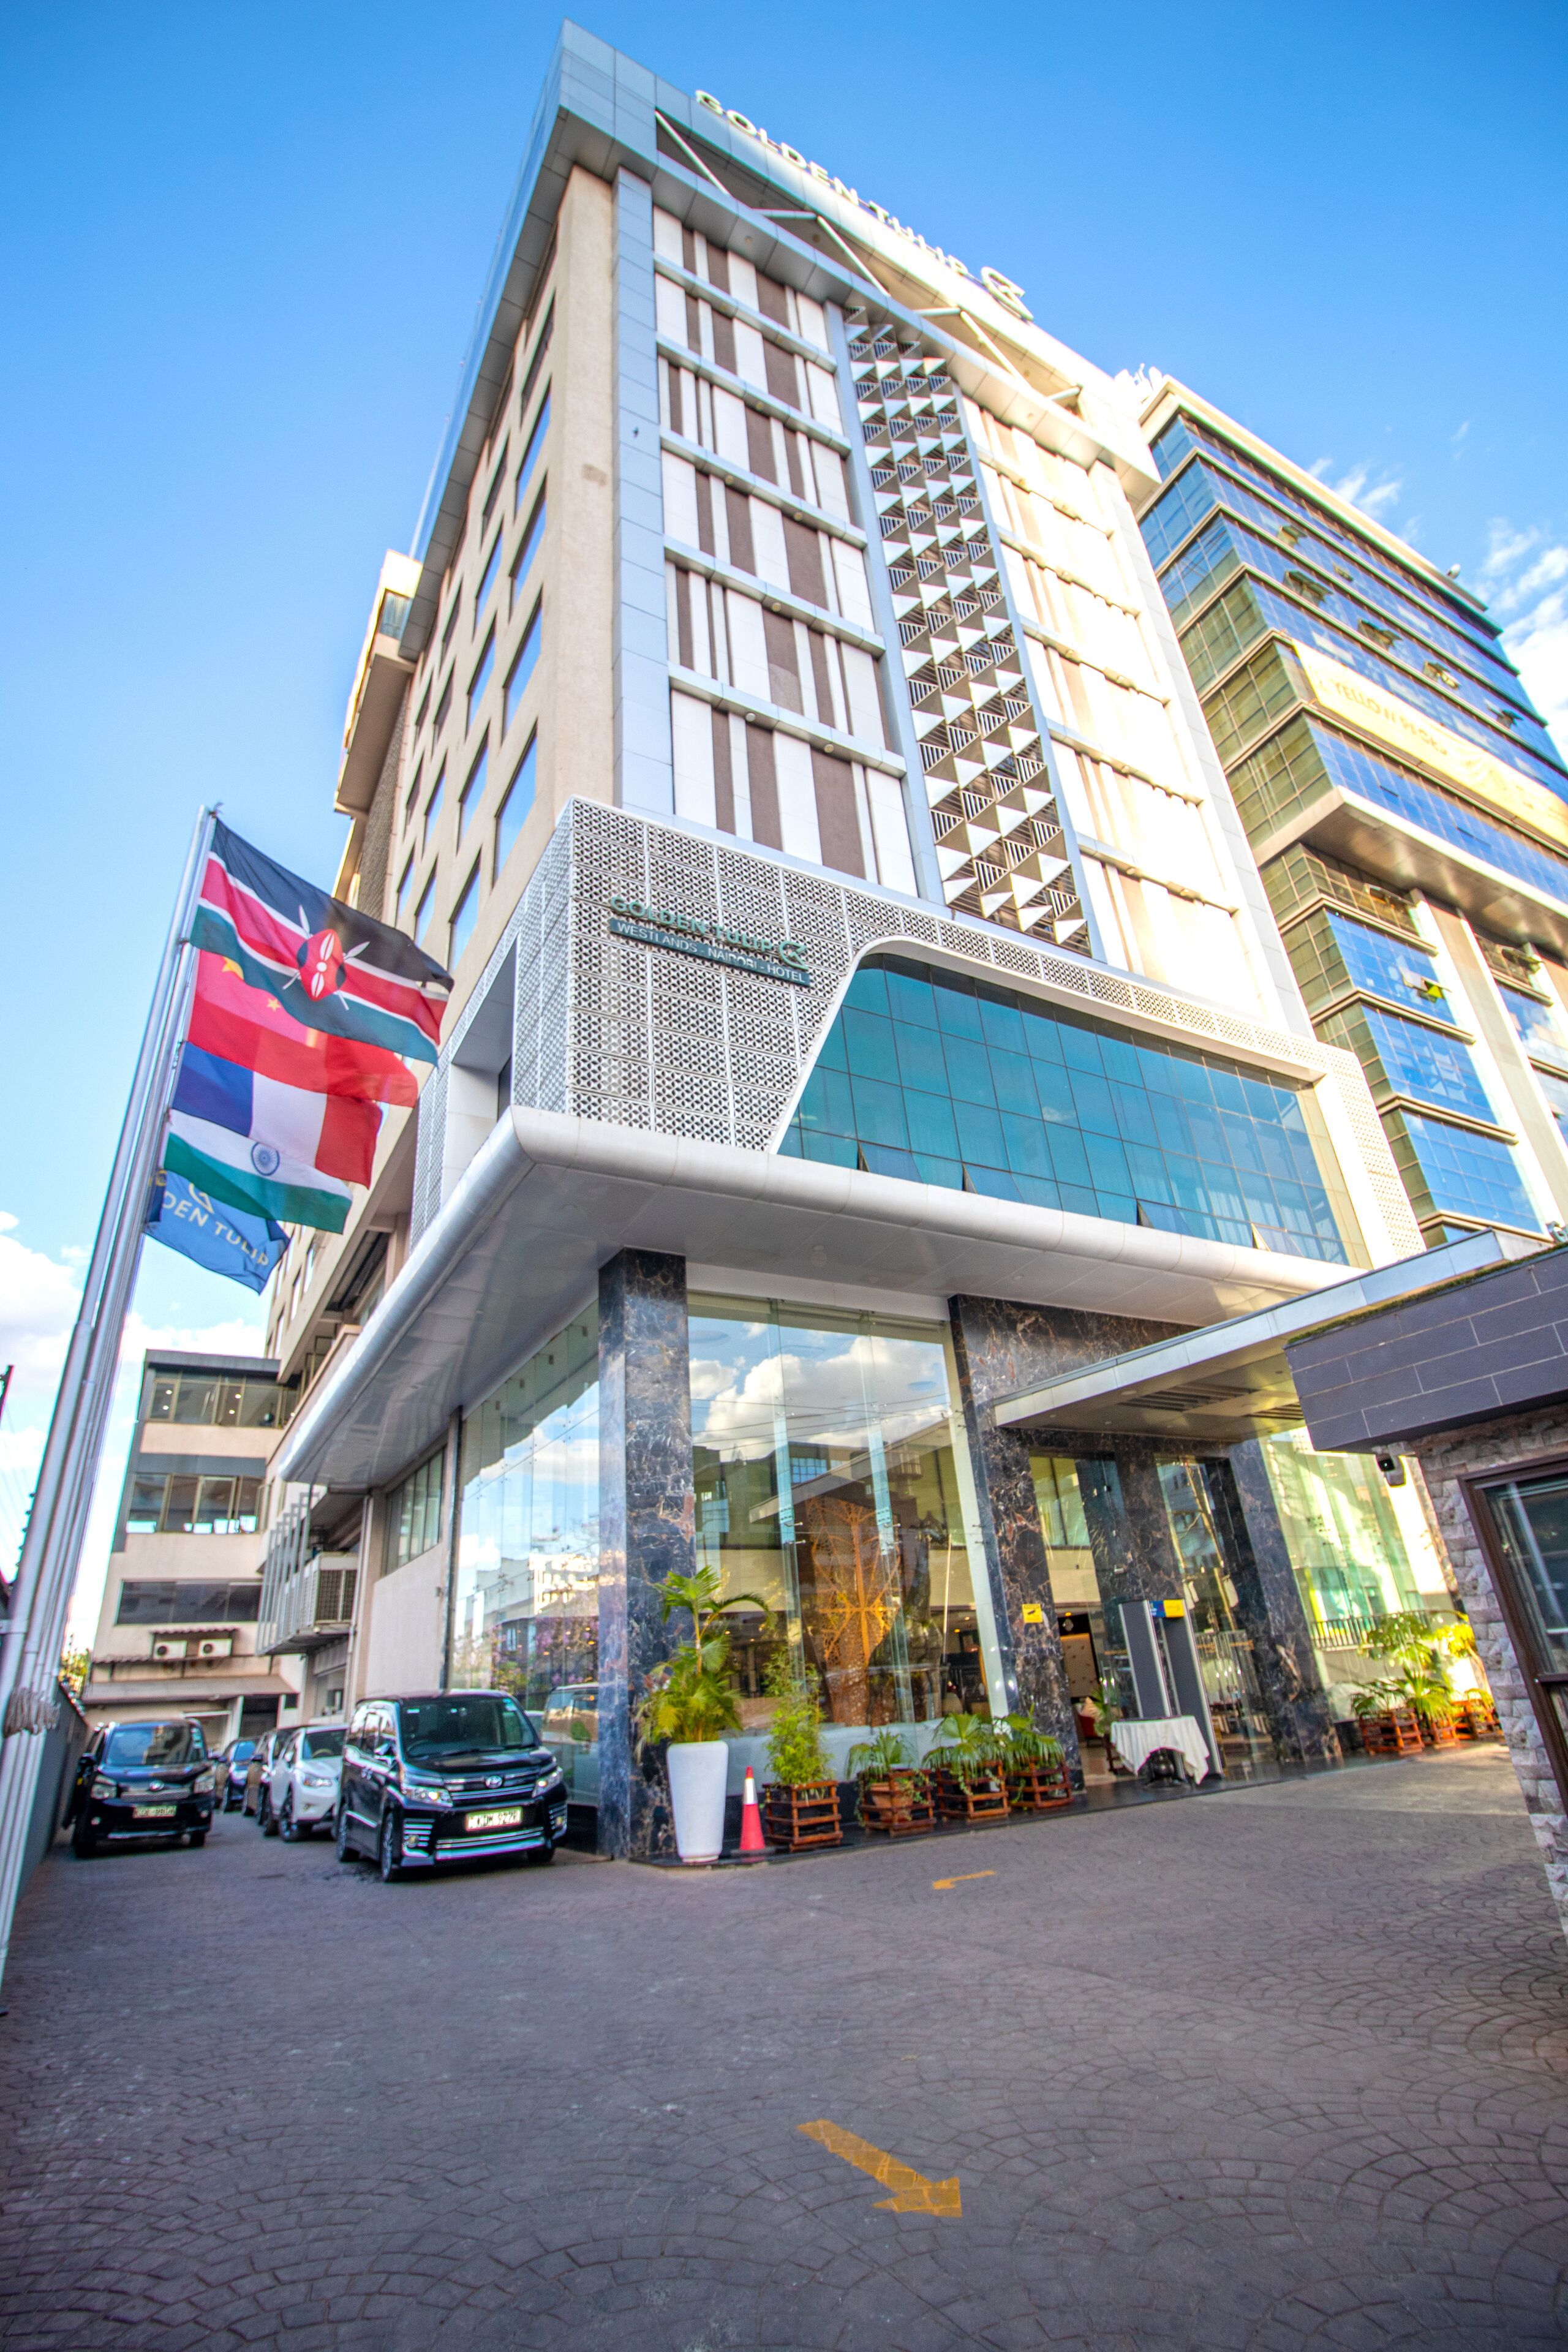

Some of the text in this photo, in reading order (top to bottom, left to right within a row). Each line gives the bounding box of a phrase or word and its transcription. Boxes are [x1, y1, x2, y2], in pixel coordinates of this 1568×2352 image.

[695, 89, 969, 276] GOLDEN TULIP
[610, 896, 773, 952] GOLDEN TULIP
[617, 922, 698, 952] WESTLANDS
[707, 948, 757, 970] NAIROBI
[767, 964, 806, 983] HOTEL
[215, 1221, 269, 1266] TULIP
